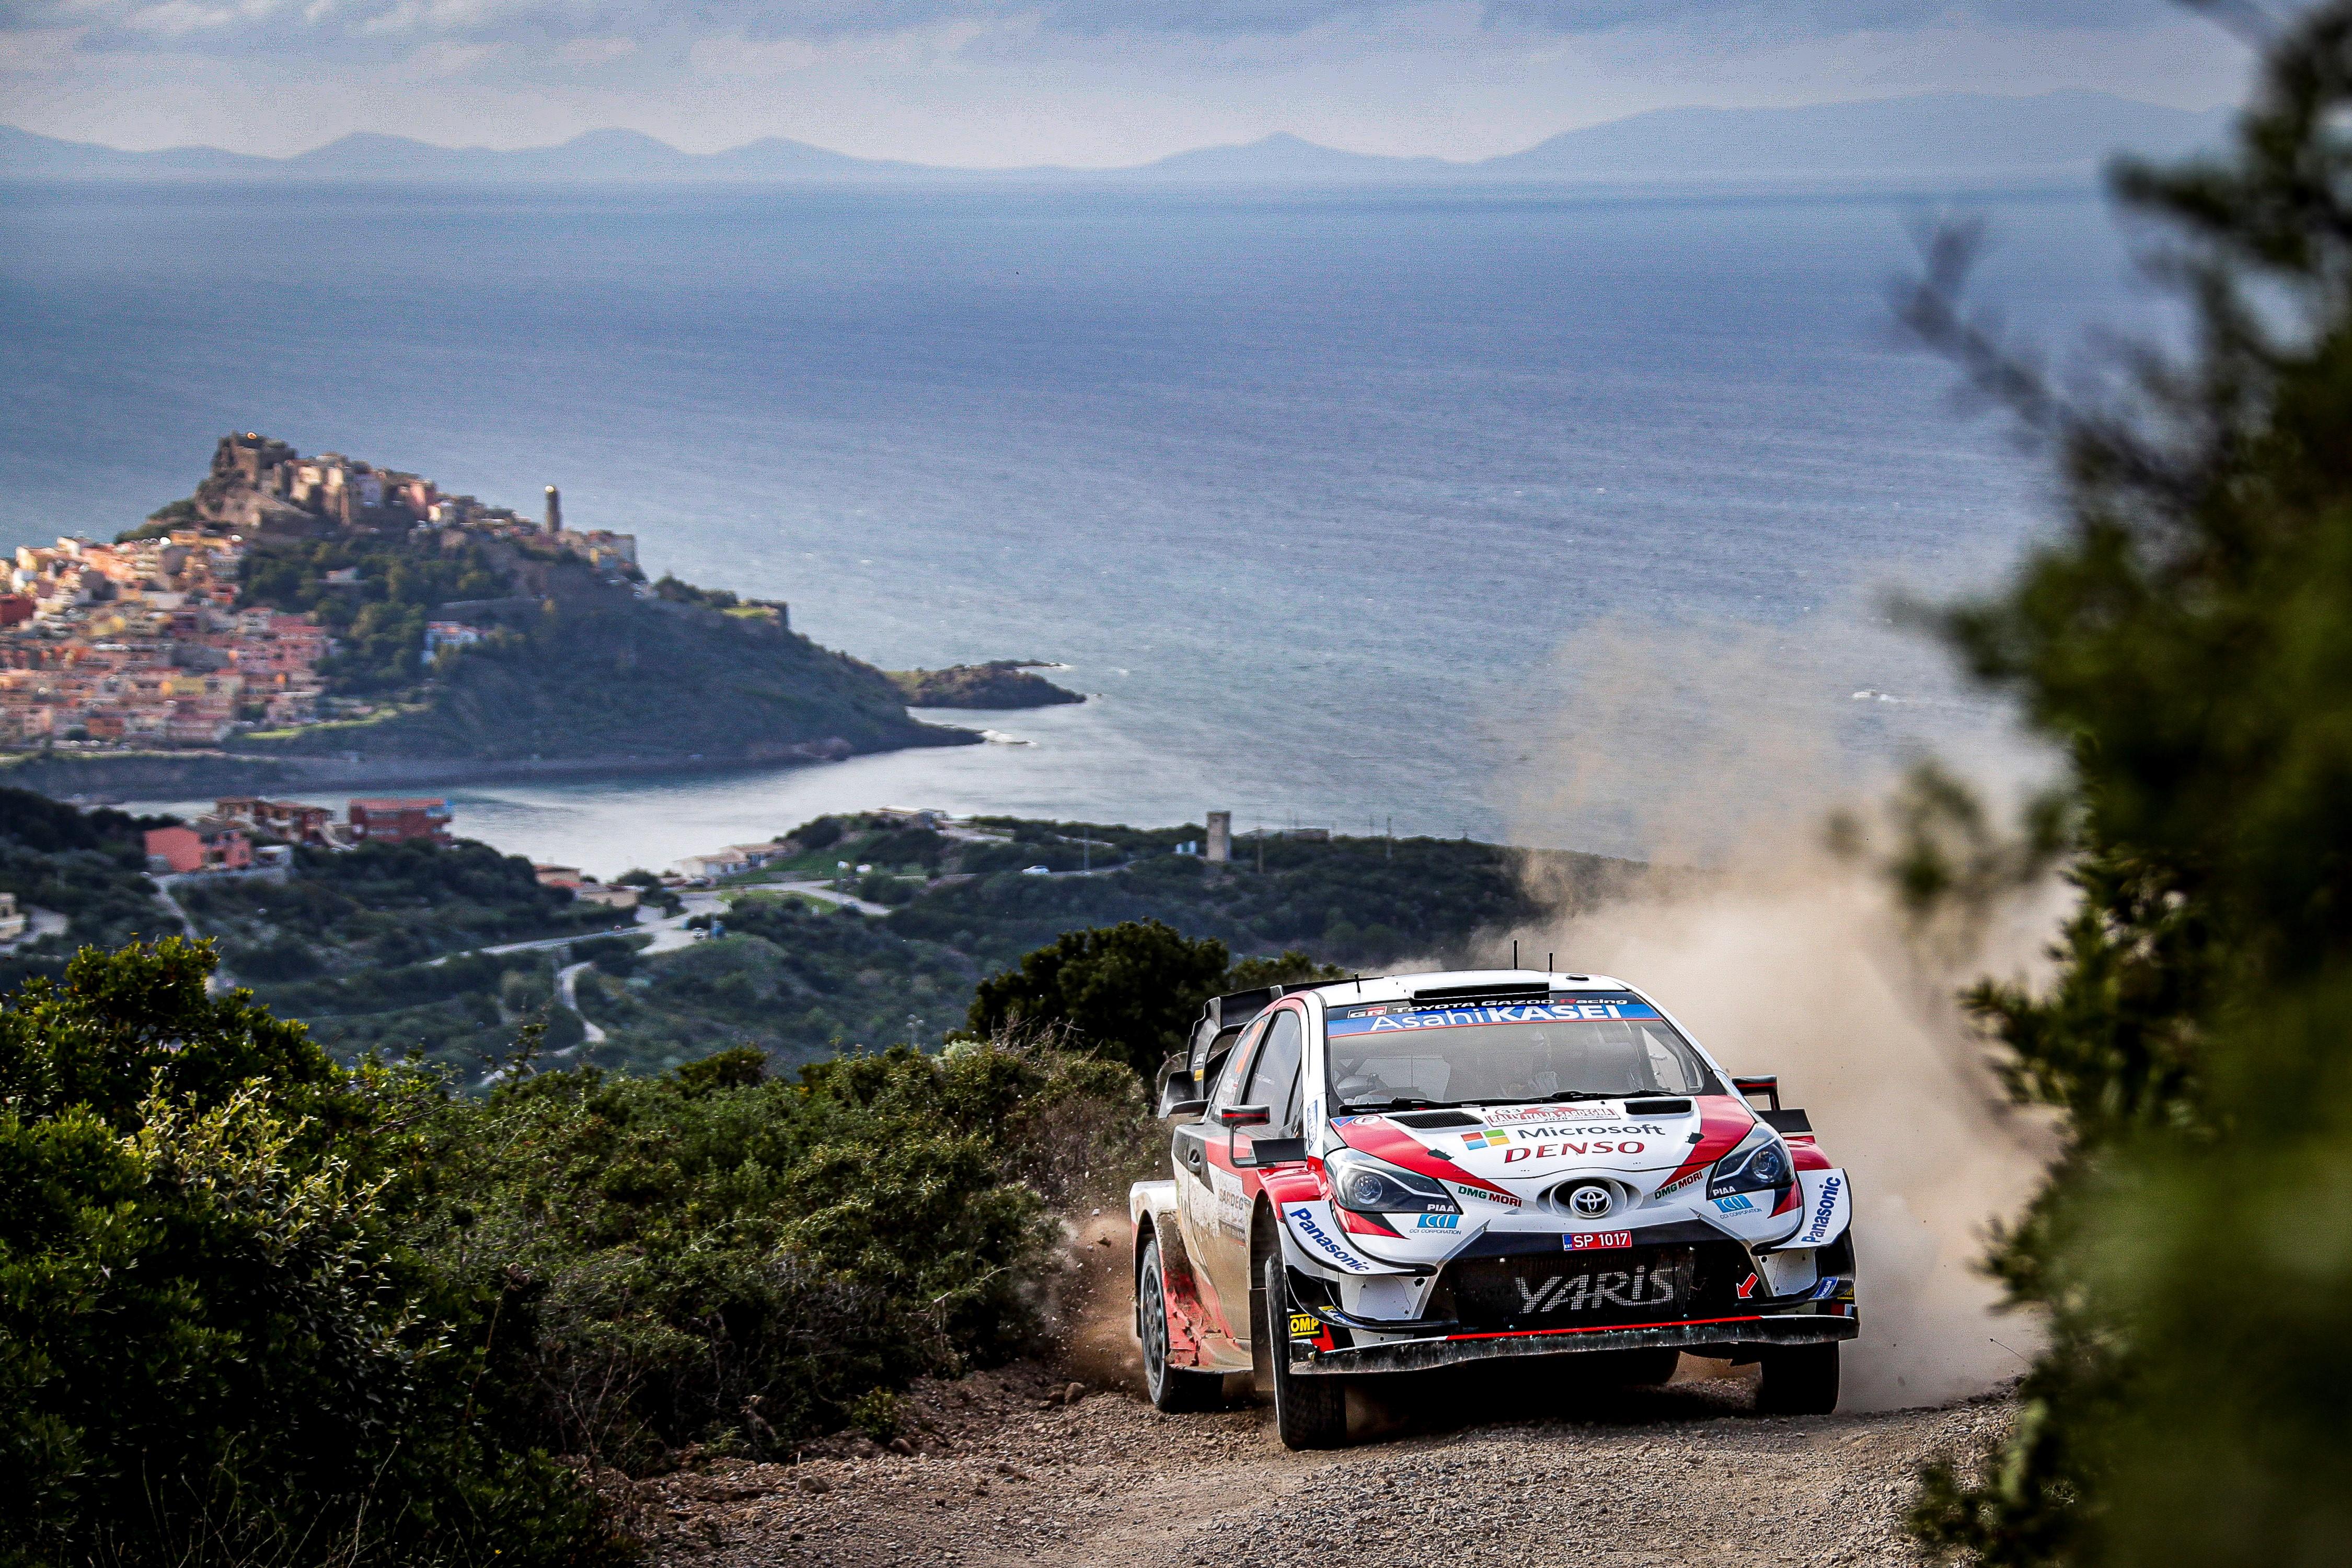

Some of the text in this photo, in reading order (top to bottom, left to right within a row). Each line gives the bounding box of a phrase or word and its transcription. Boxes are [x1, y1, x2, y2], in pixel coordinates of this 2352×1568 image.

[1350, 1009, 1385, 1018] GR
[1392, 1002, 1475, 1013] TOYOTA
[1491, 1114, 1522, 1123] RALLY
[1524, 1112, 1558, 1120] ITALIA
[1558, 1109, 1611, 1117] SARDEGNA
[1517, 1124, 1666, 1139] Microsoft
[1504, 1142, 1645, 1163] DENSO
[1654, 1171, 1703, 1200] DMG MORI
[1712, 1186, 1736, 1196] PIAA
[1457, 1185, 1523, 1207] DMG MORI
[1427, 1204, 1455, 1212] PIAA
[1729, 1208, 1762, 1216] CORPORATION
[1801, 1176, 1841, 1243] Panasonic
[1289, 1207, 1370, 1272] Panasonic
[1573, 1232, 1628, 1248] SP 1017
[1290, 1318, 1319, 1332] OMP
